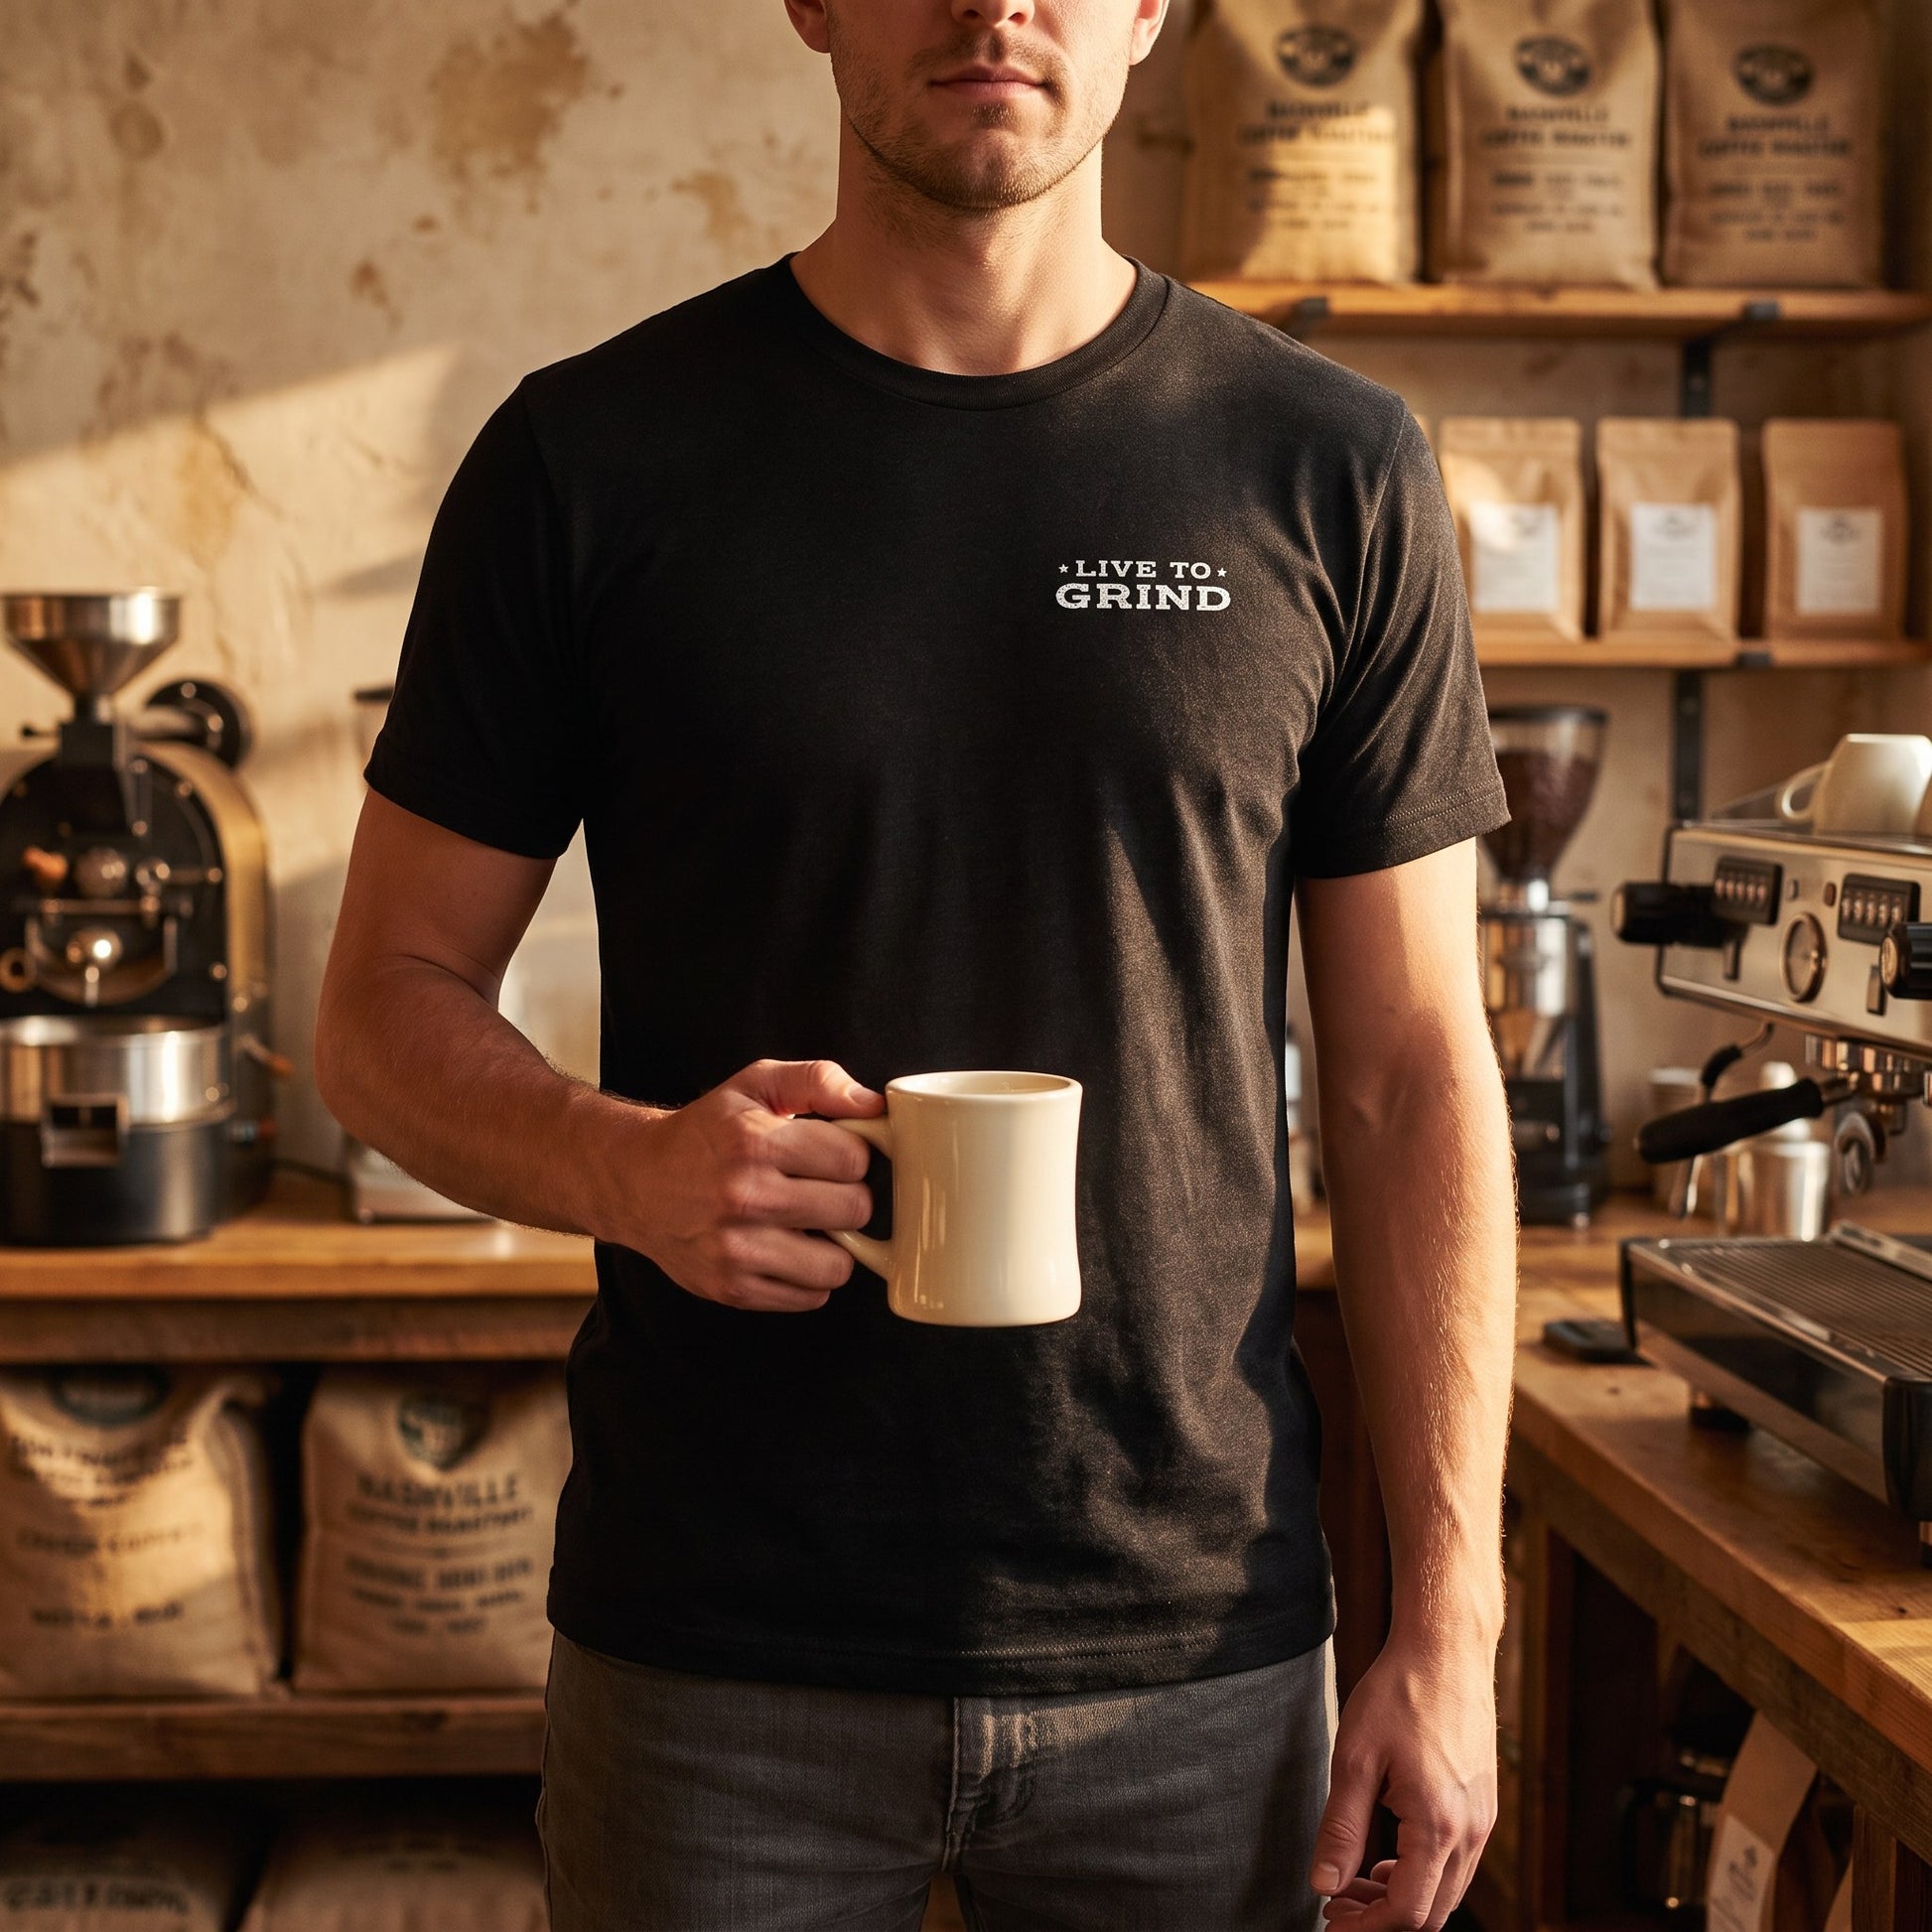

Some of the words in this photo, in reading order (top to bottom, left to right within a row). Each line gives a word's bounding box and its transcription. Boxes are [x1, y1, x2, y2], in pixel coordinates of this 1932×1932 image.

[1075, 559, 1157, 578] LIVE
[1170, 562, 1211, 580] TO
[1055, 583, 1231, 612] GRIND
